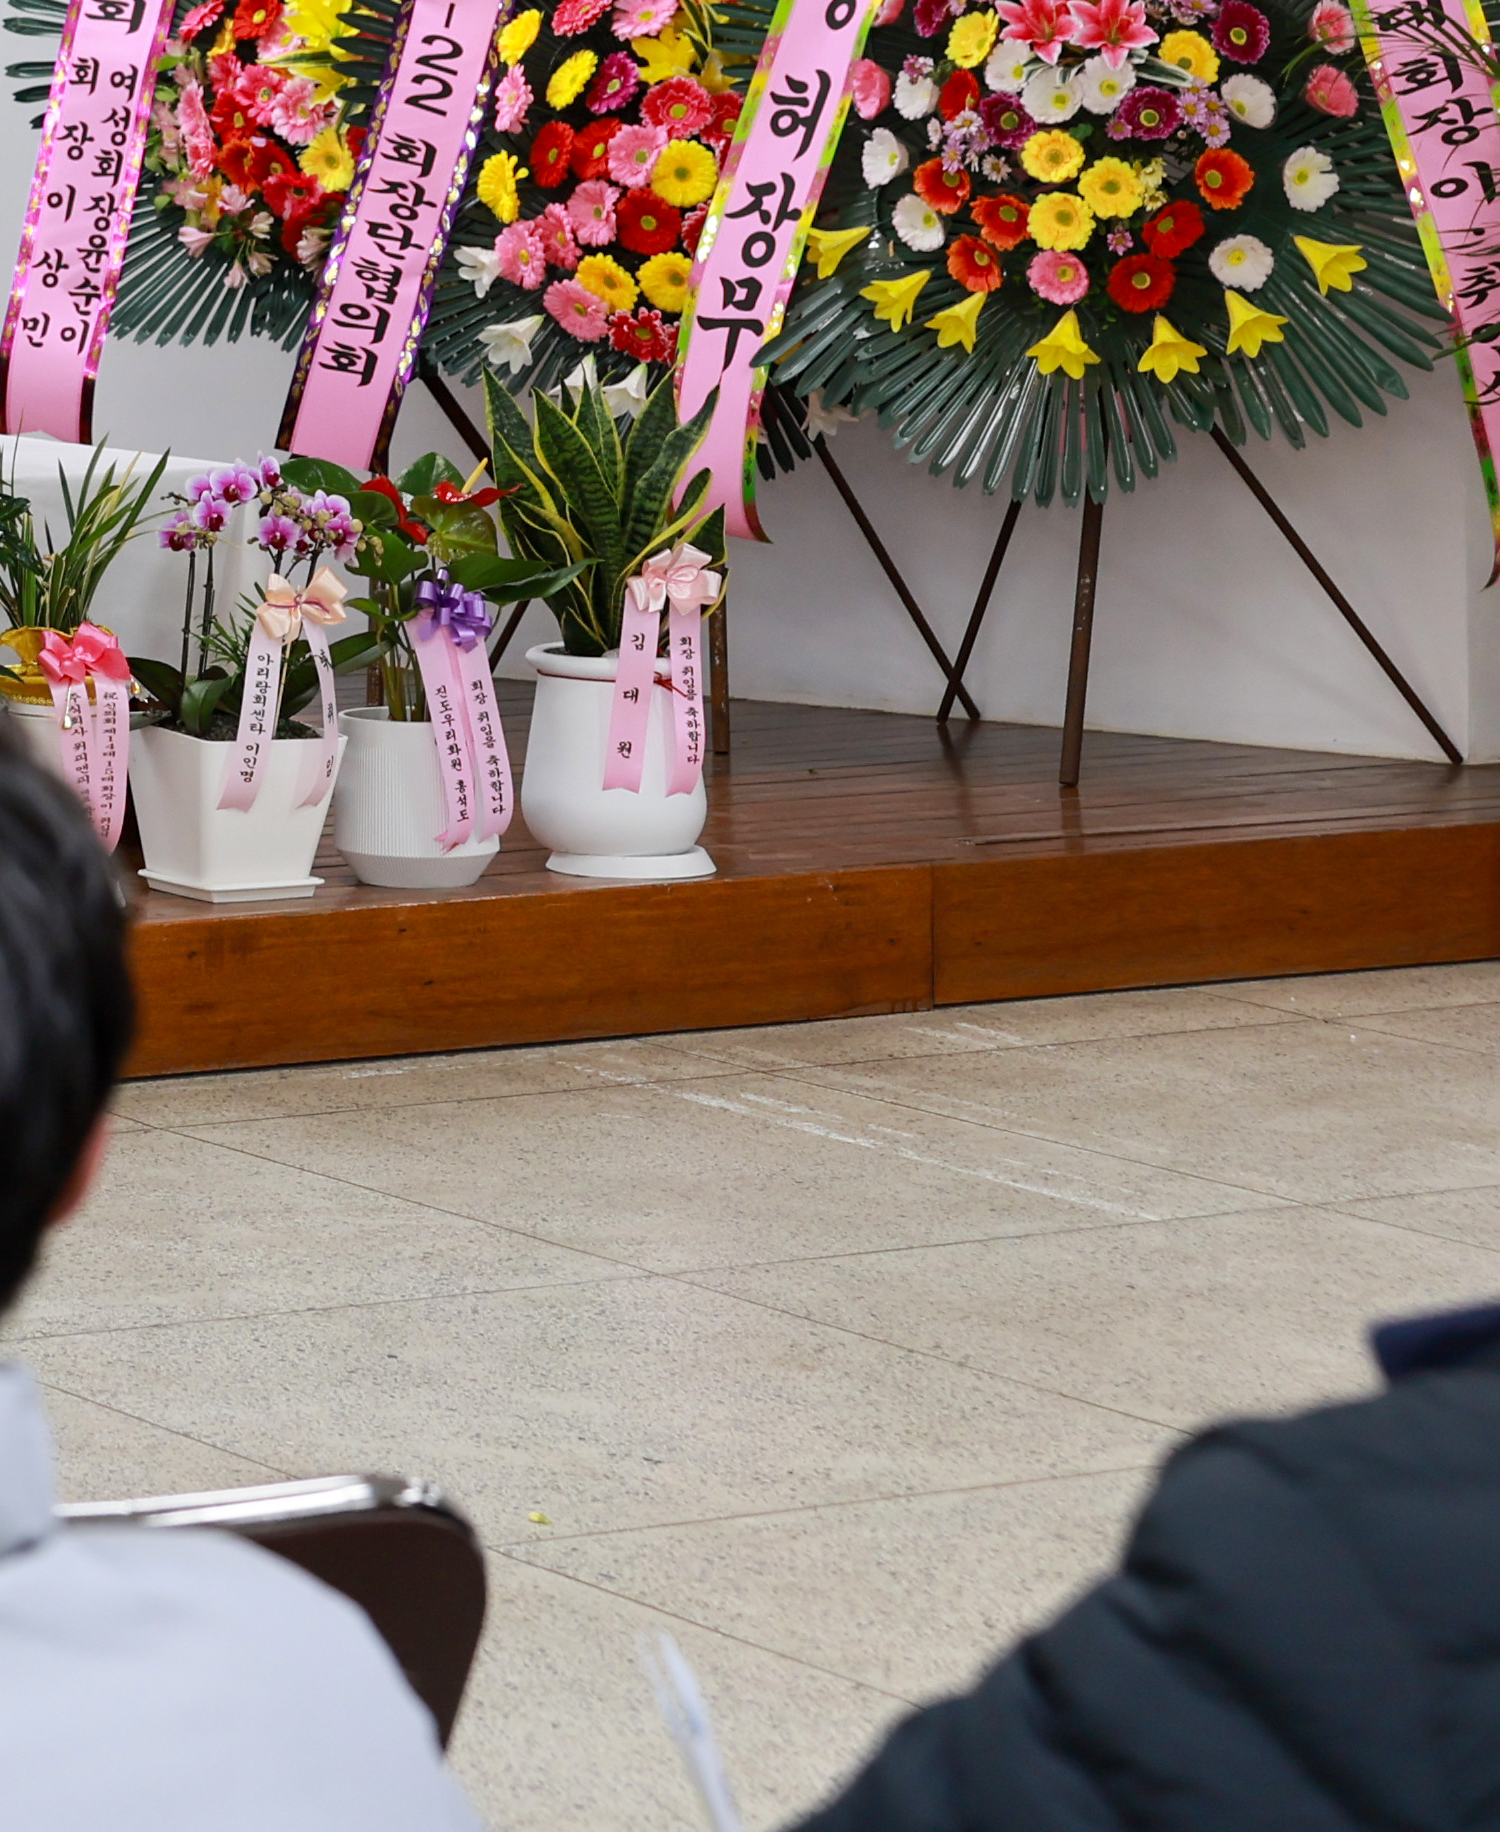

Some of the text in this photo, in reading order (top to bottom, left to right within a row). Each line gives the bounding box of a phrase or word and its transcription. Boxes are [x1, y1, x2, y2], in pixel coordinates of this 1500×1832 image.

[679, 635, 695, 660] 회장
[470, 678, 488, 706] 회장
[486, 754, 506, 816] 축하합니다
[685, 706, 701, 766] 축하합니다
